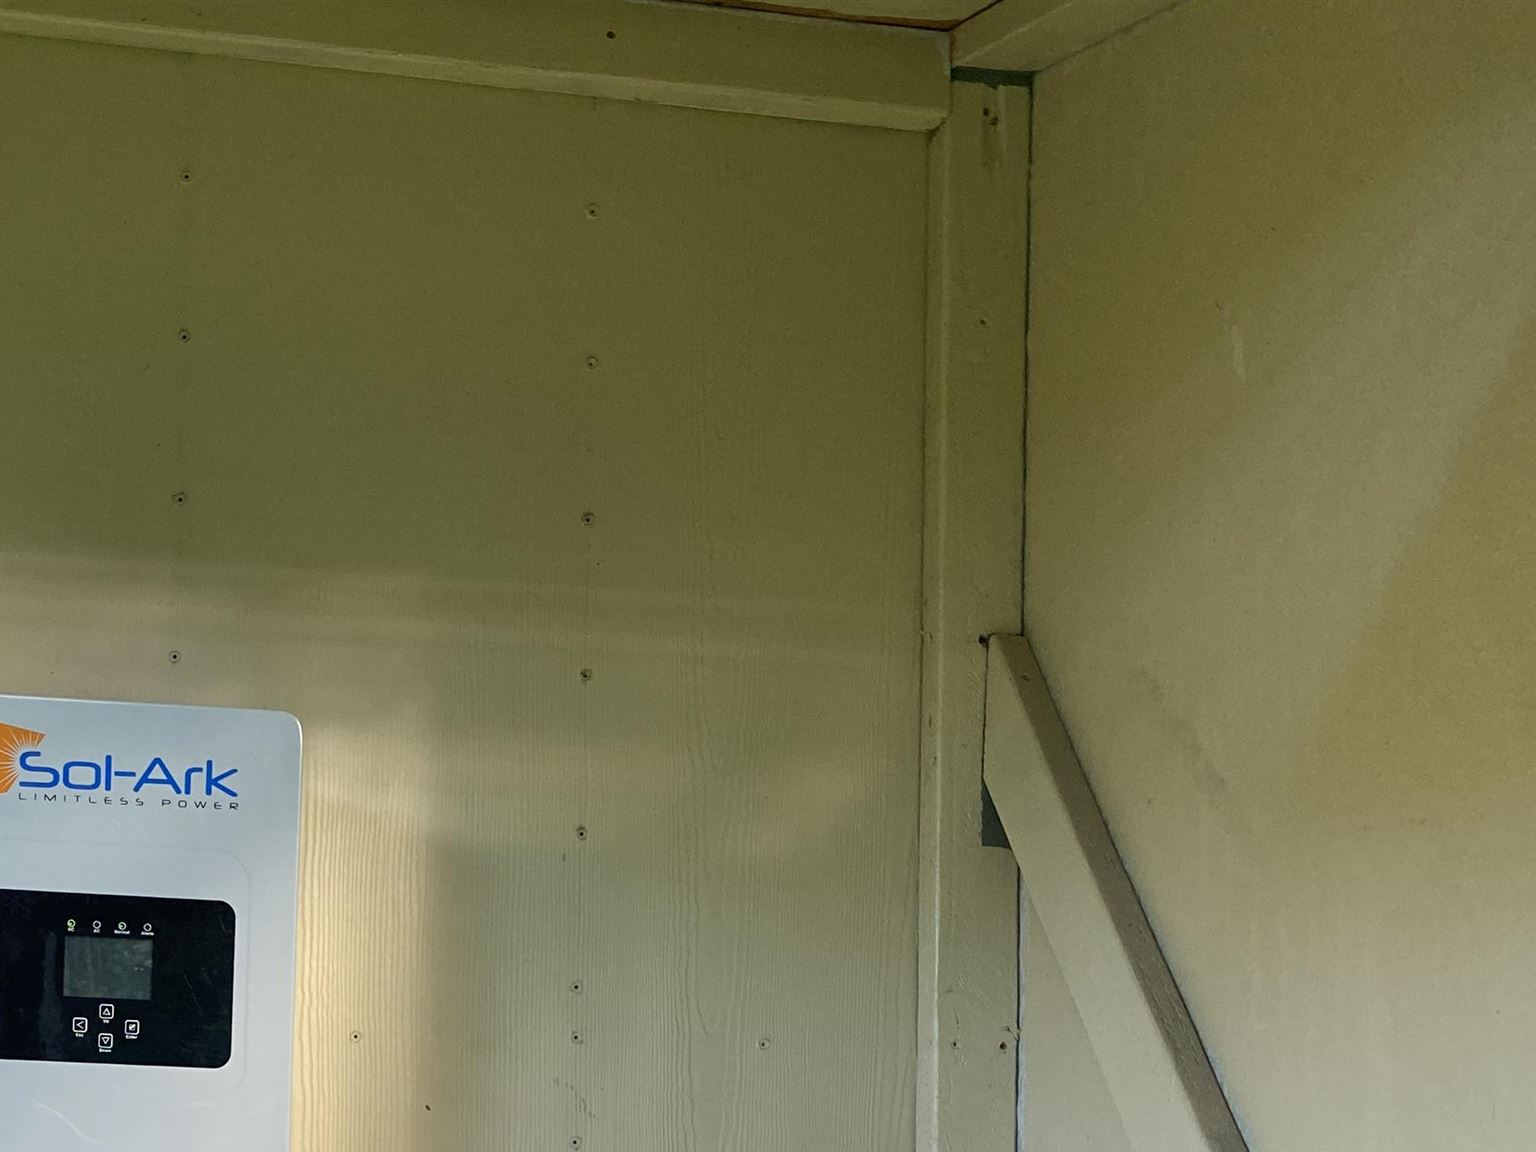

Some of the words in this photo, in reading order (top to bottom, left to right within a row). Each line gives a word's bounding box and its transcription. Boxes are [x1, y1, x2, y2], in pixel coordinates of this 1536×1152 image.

[18, 751, 239, 798] Sol-Ark
[18, 792, 145, 807] LIMITLESS
[161, 798, 239, 811] POWER
